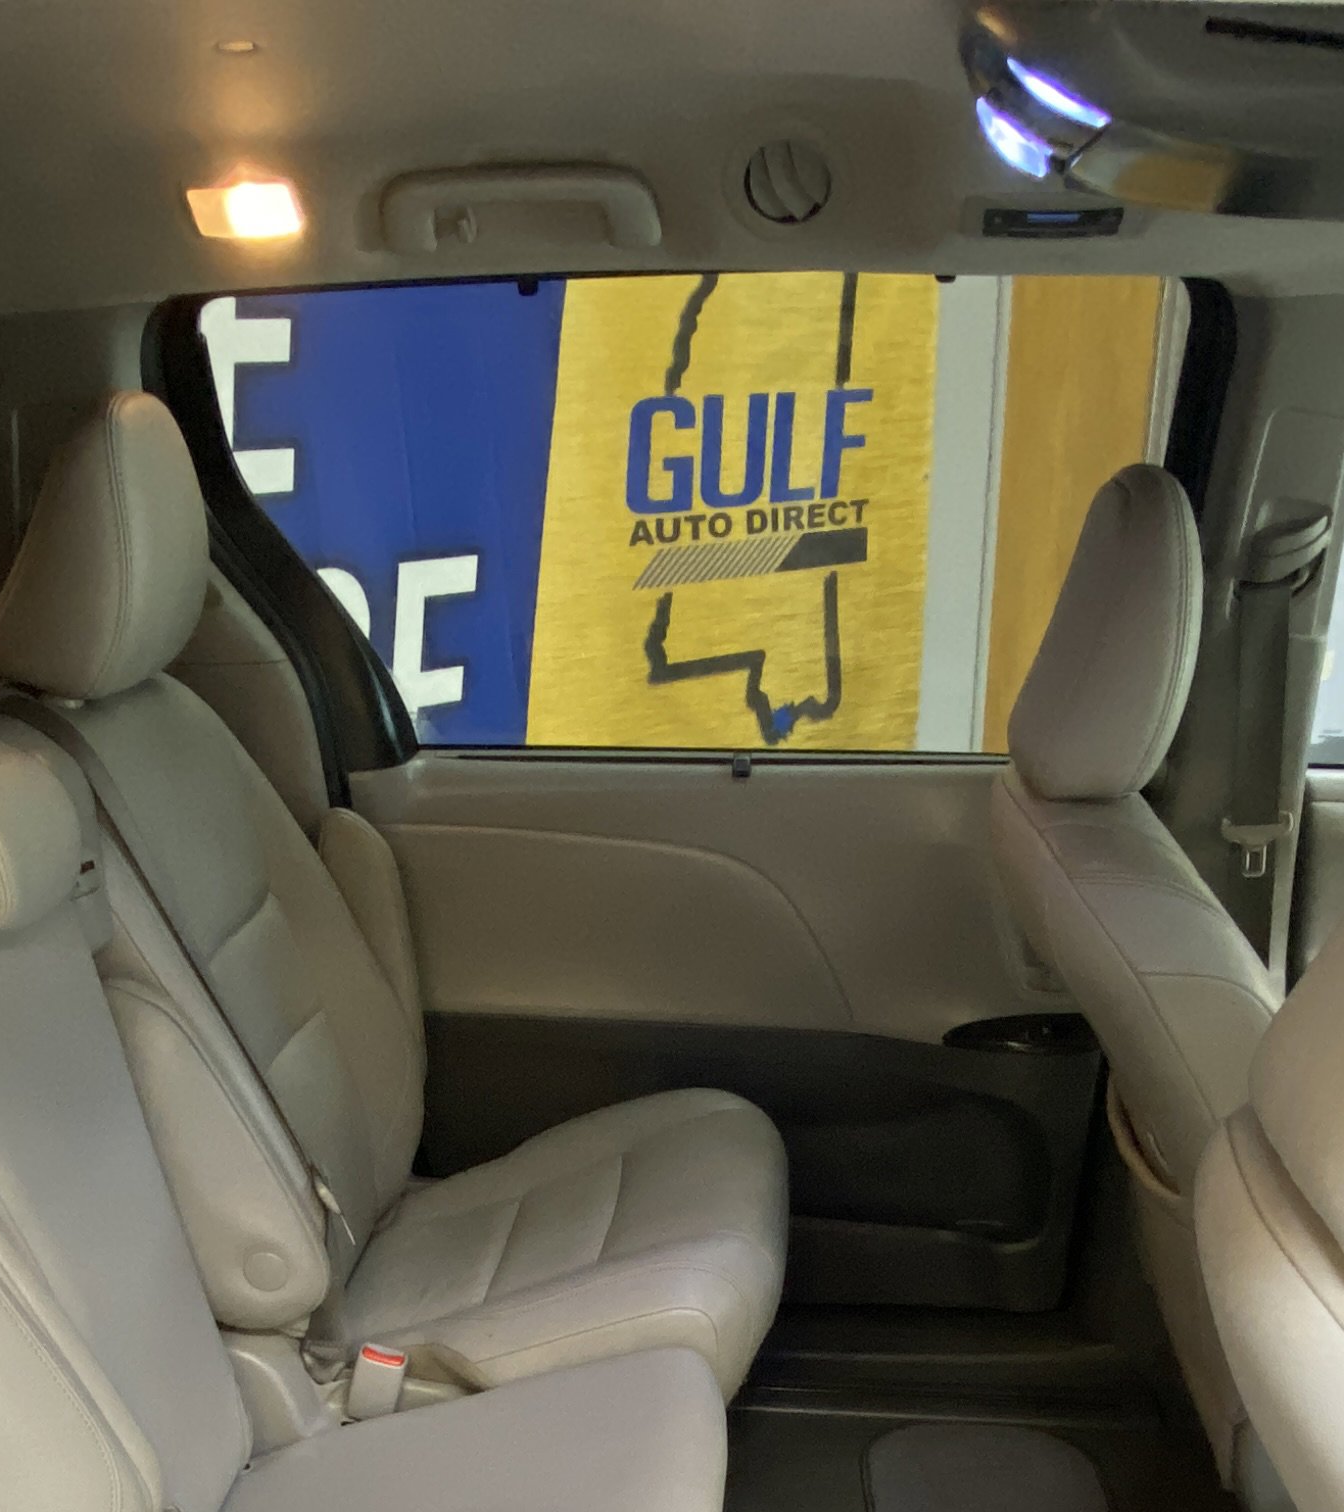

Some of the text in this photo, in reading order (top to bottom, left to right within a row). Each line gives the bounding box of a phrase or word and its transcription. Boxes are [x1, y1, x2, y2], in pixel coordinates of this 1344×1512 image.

[626, 388, 874, 514] GULF
[629, 498, 870, 547] AUTO DIRECT
